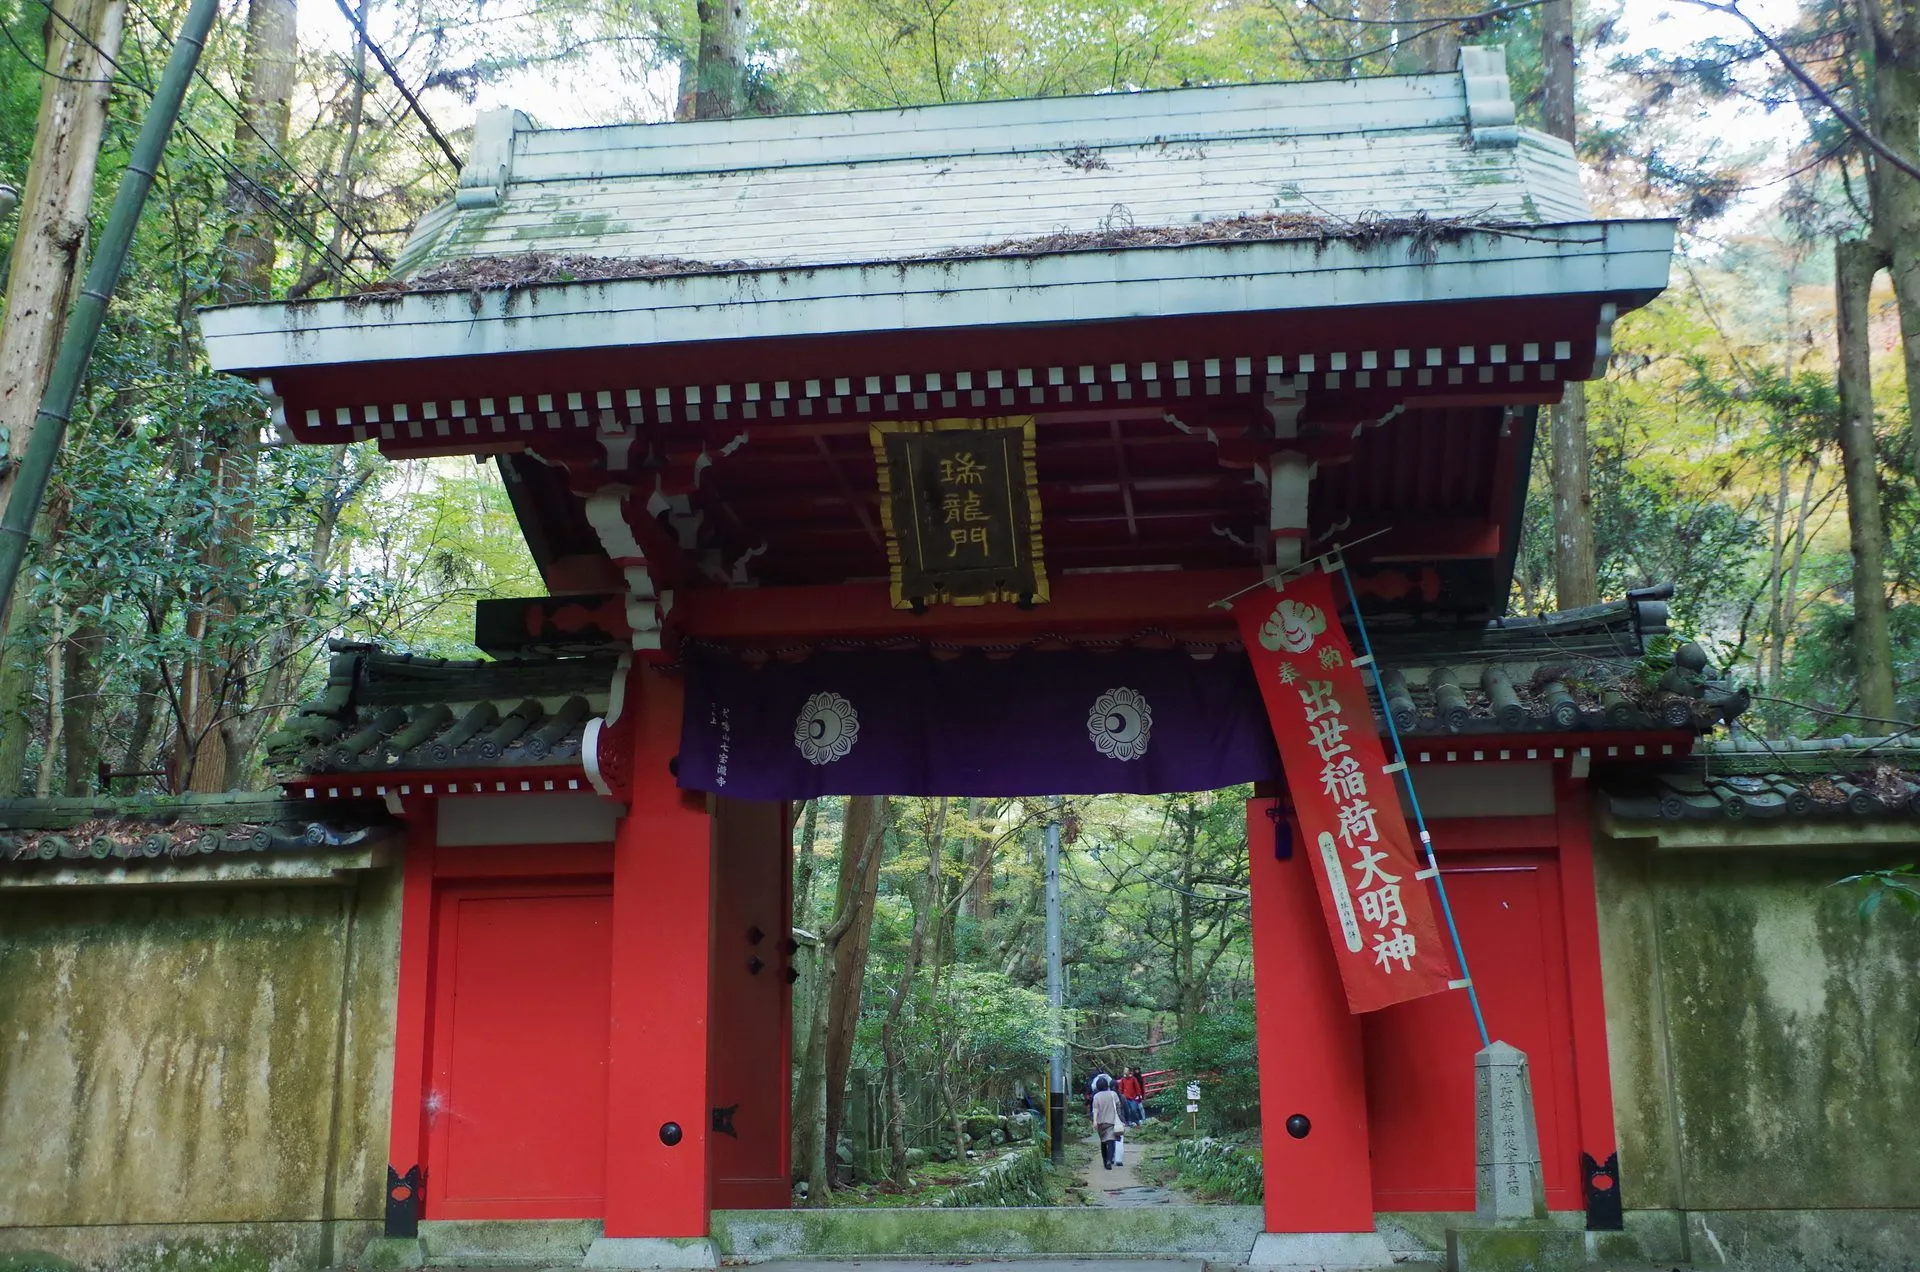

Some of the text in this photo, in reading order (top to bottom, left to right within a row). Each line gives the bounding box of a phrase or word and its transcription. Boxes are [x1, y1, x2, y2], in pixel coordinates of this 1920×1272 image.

[939, 451, 993, 558] 瑞龍門
[1278, 646, 1344, 686] 奉納
[1298, 680, 1416, 974] 出世稲荷大明神
